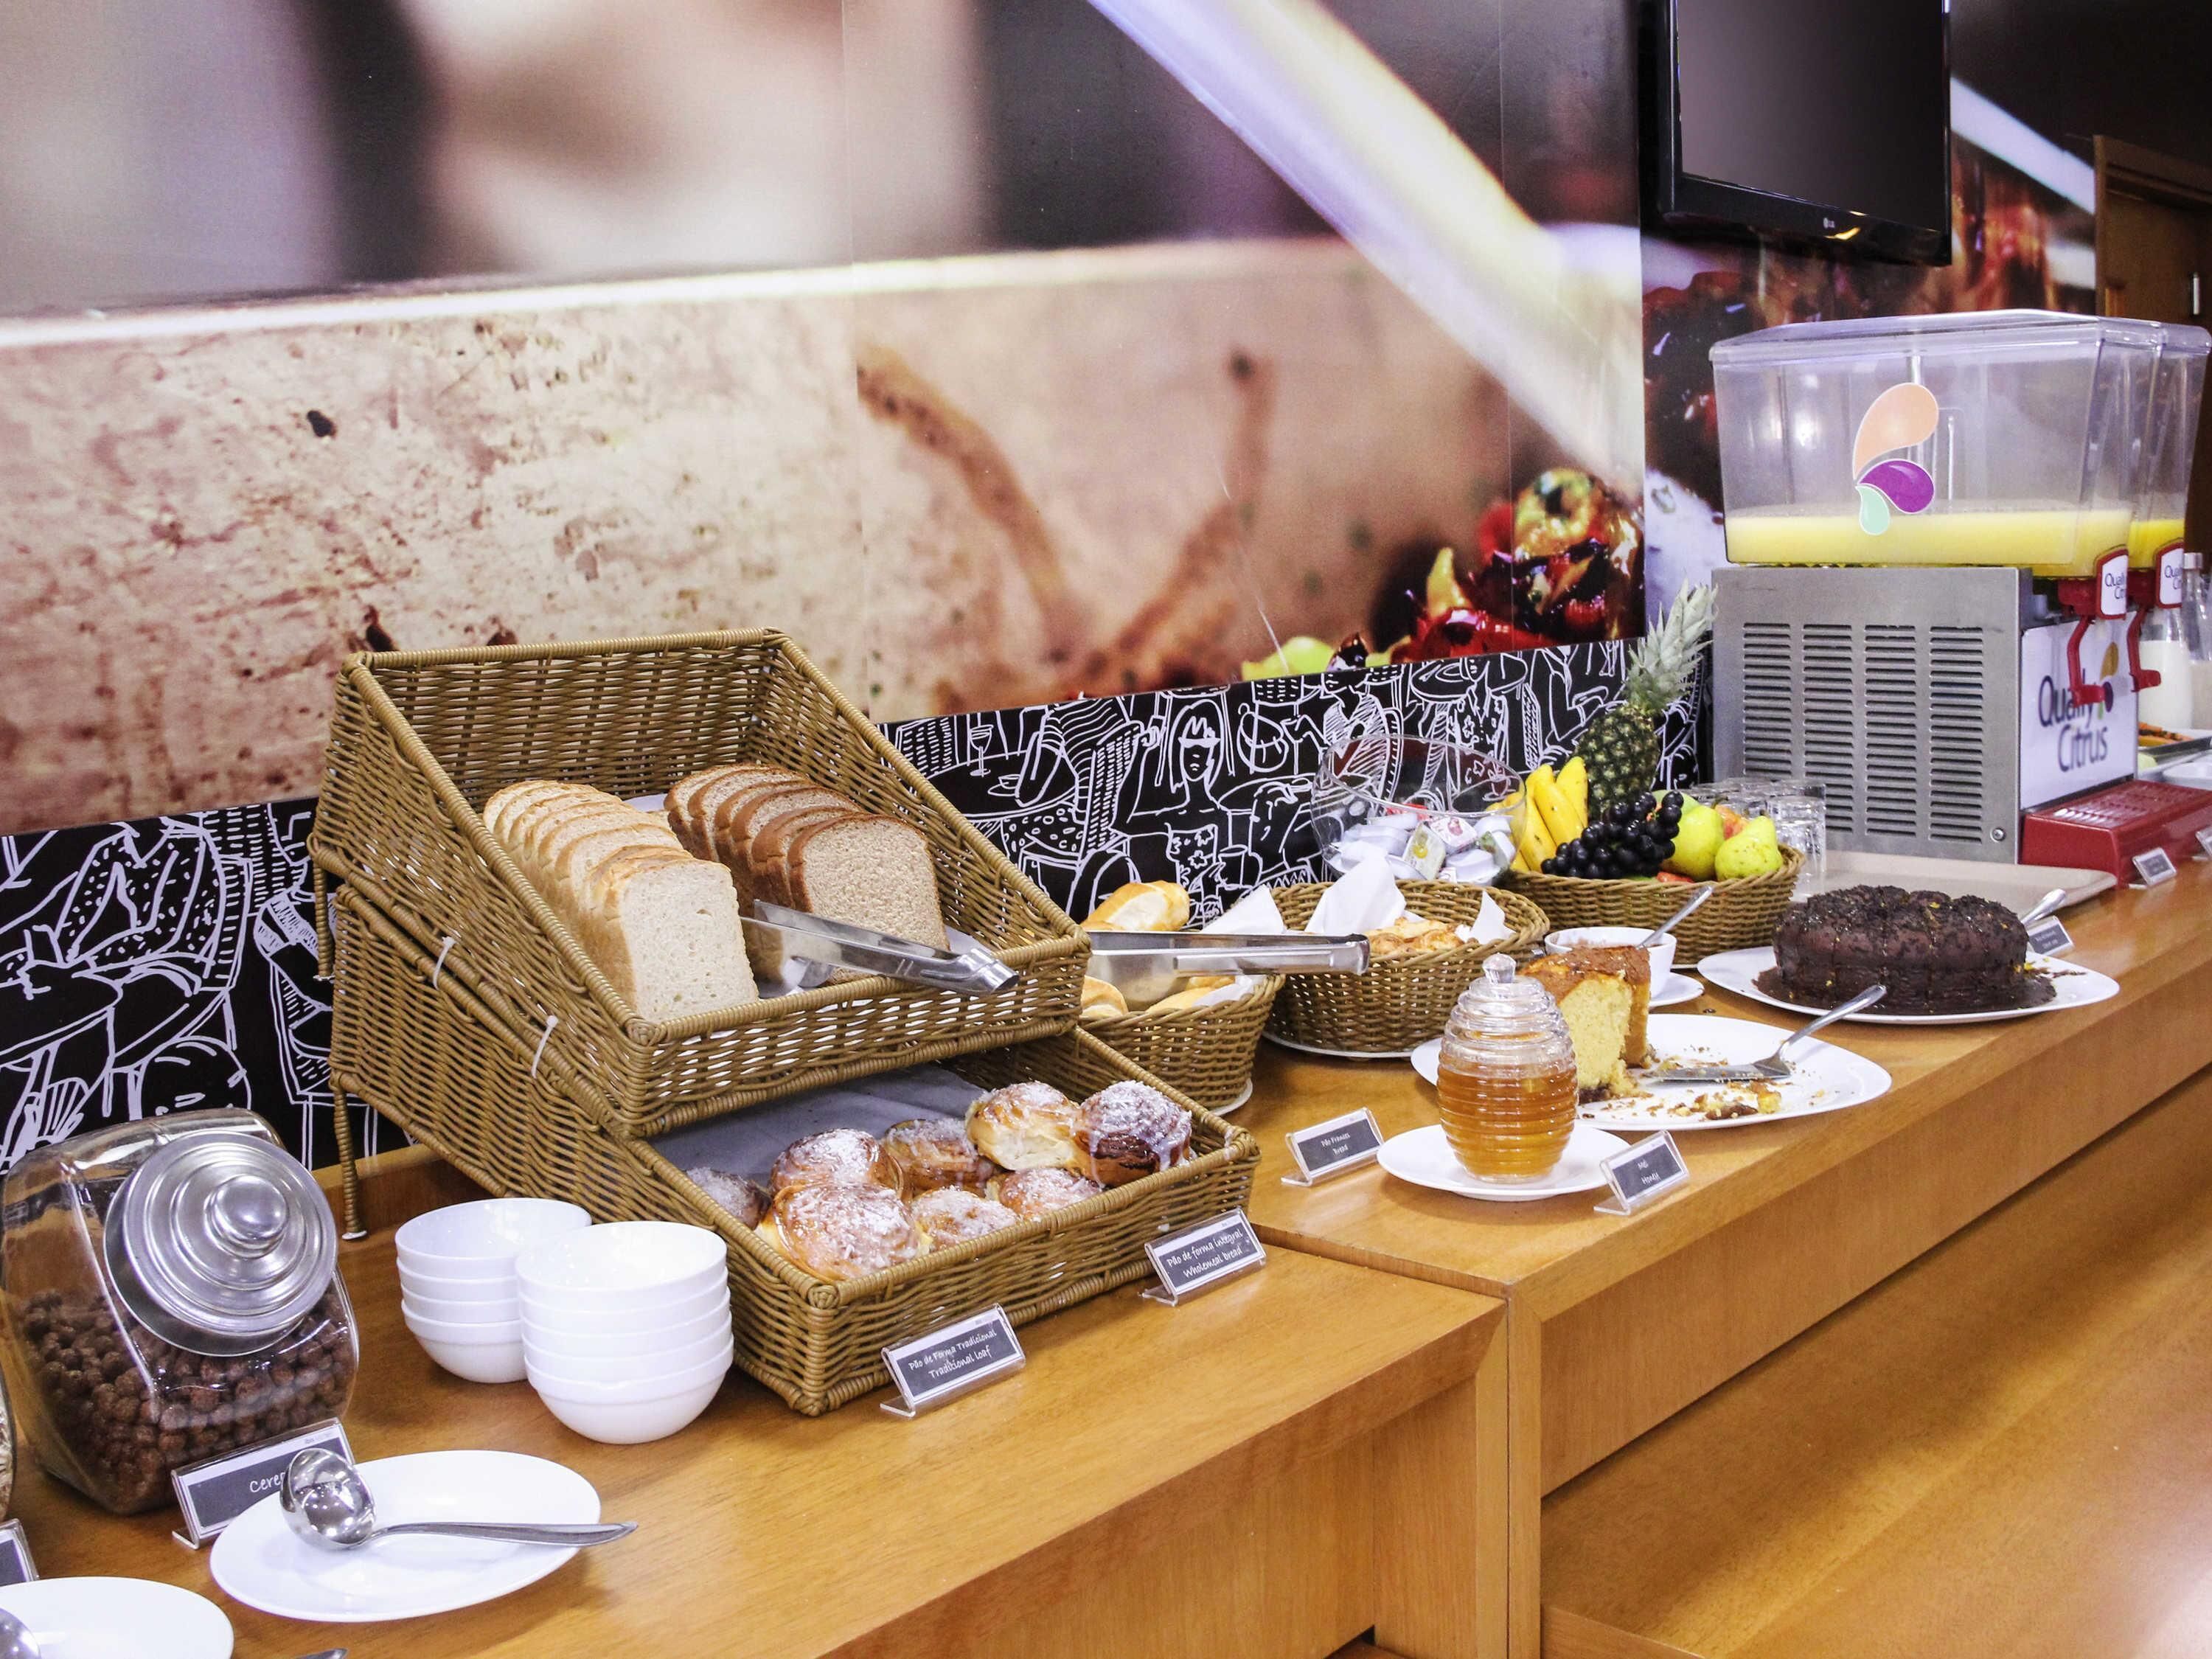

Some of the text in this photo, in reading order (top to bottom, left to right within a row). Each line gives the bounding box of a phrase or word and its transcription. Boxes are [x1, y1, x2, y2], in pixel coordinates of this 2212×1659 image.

[2039, 667, 2097, 728] Qualy
[2058, 723, 2108, 772] Citrus
[1166, 1228, 1243, 1267] Pão de forma integral
[1222, 1245, 1243, 1261] bread
[908, 1328, 997, 1371] Pão de Forma Tradicional
[928, 1344, 992, 1379] Traditional loaf
